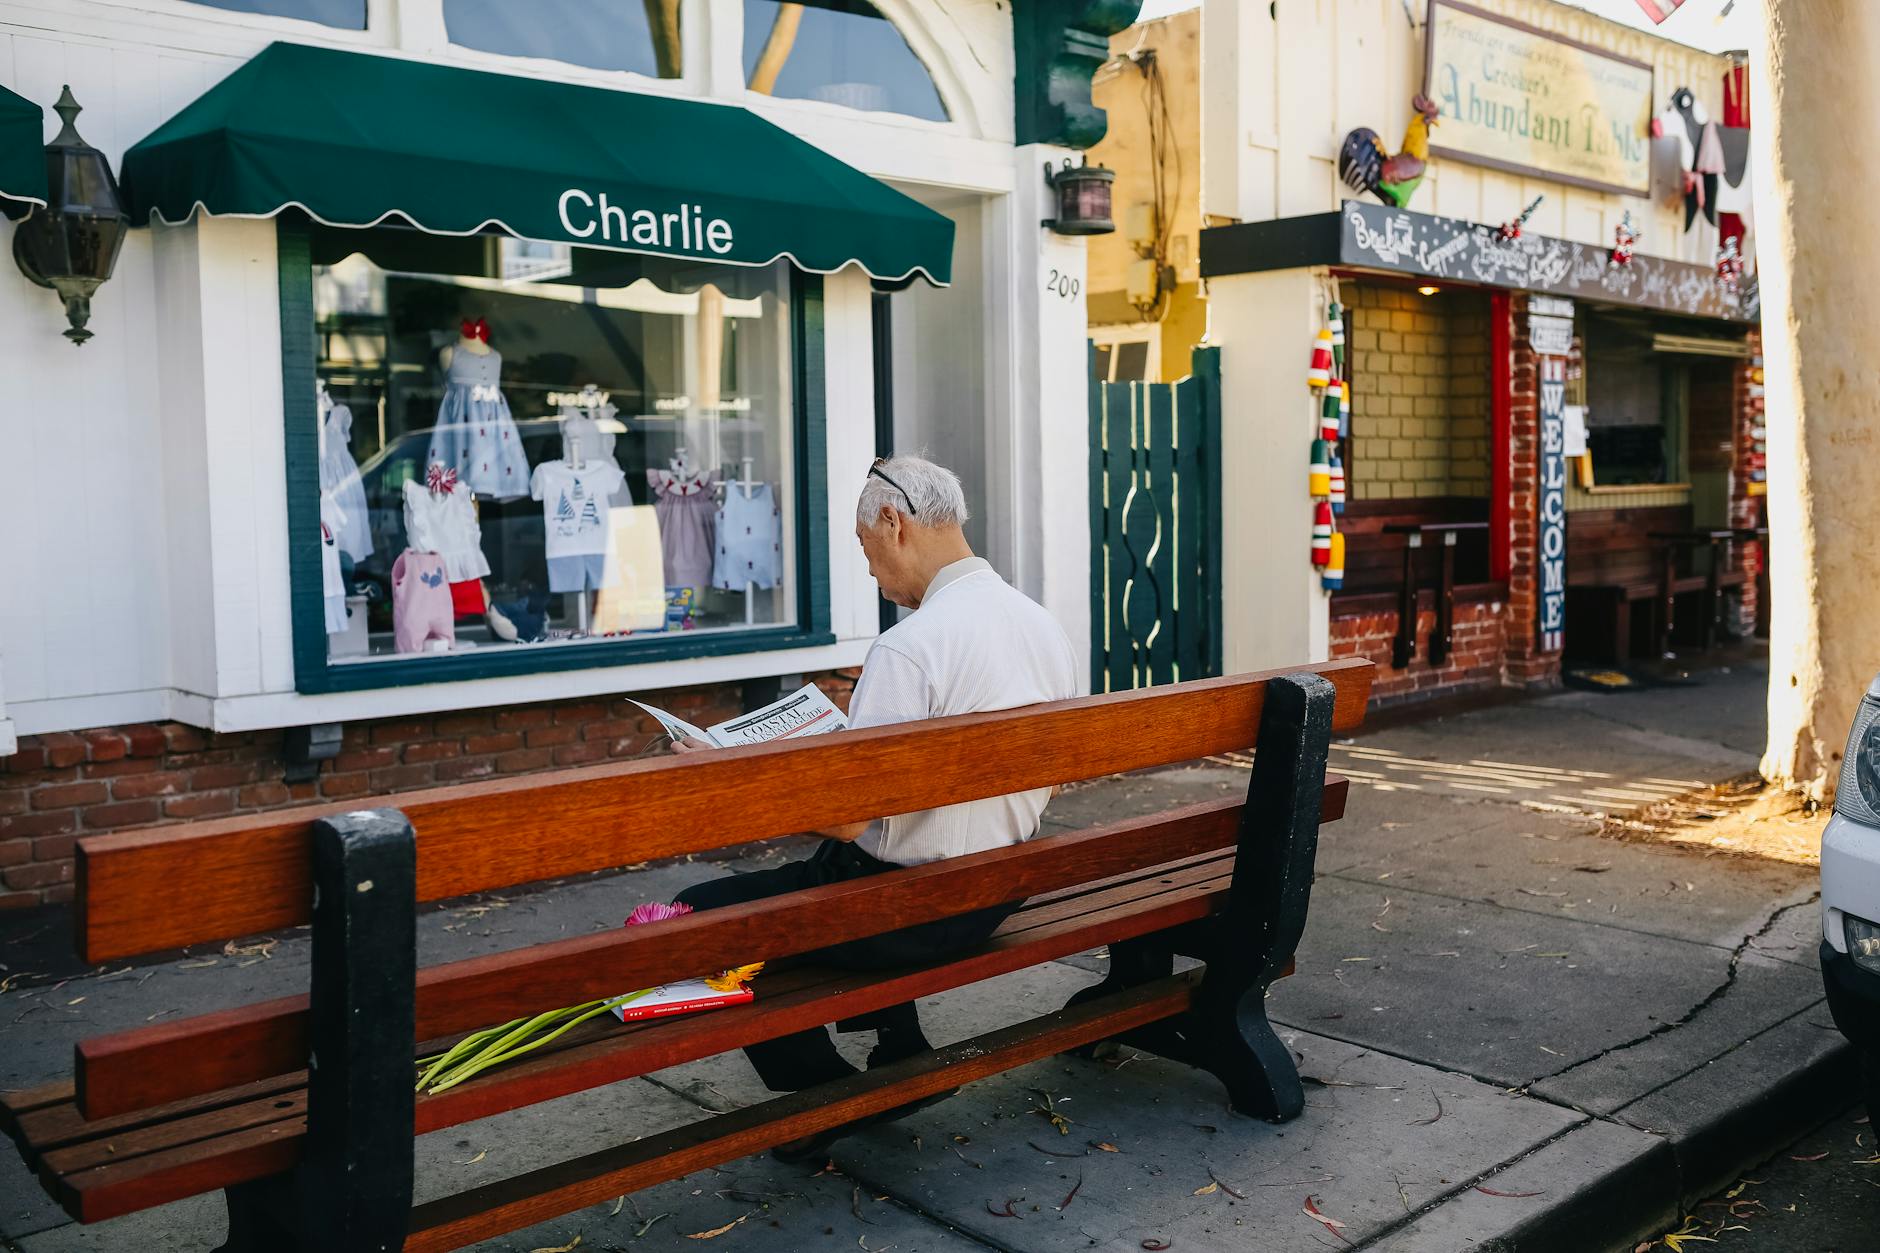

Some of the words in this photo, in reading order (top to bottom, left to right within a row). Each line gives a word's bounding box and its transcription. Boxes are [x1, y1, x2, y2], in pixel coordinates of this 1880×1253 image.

[1439, 62, 1570, 148] Abundant
[558, 188, 733, 254] Charlie
[1047, 269, 1080, 304] 209
[1541, 383, 1565, 630] WELCOME
[742, 708, 806, 739] COASTAL
[796, 706, 825, 727] GUIDE
